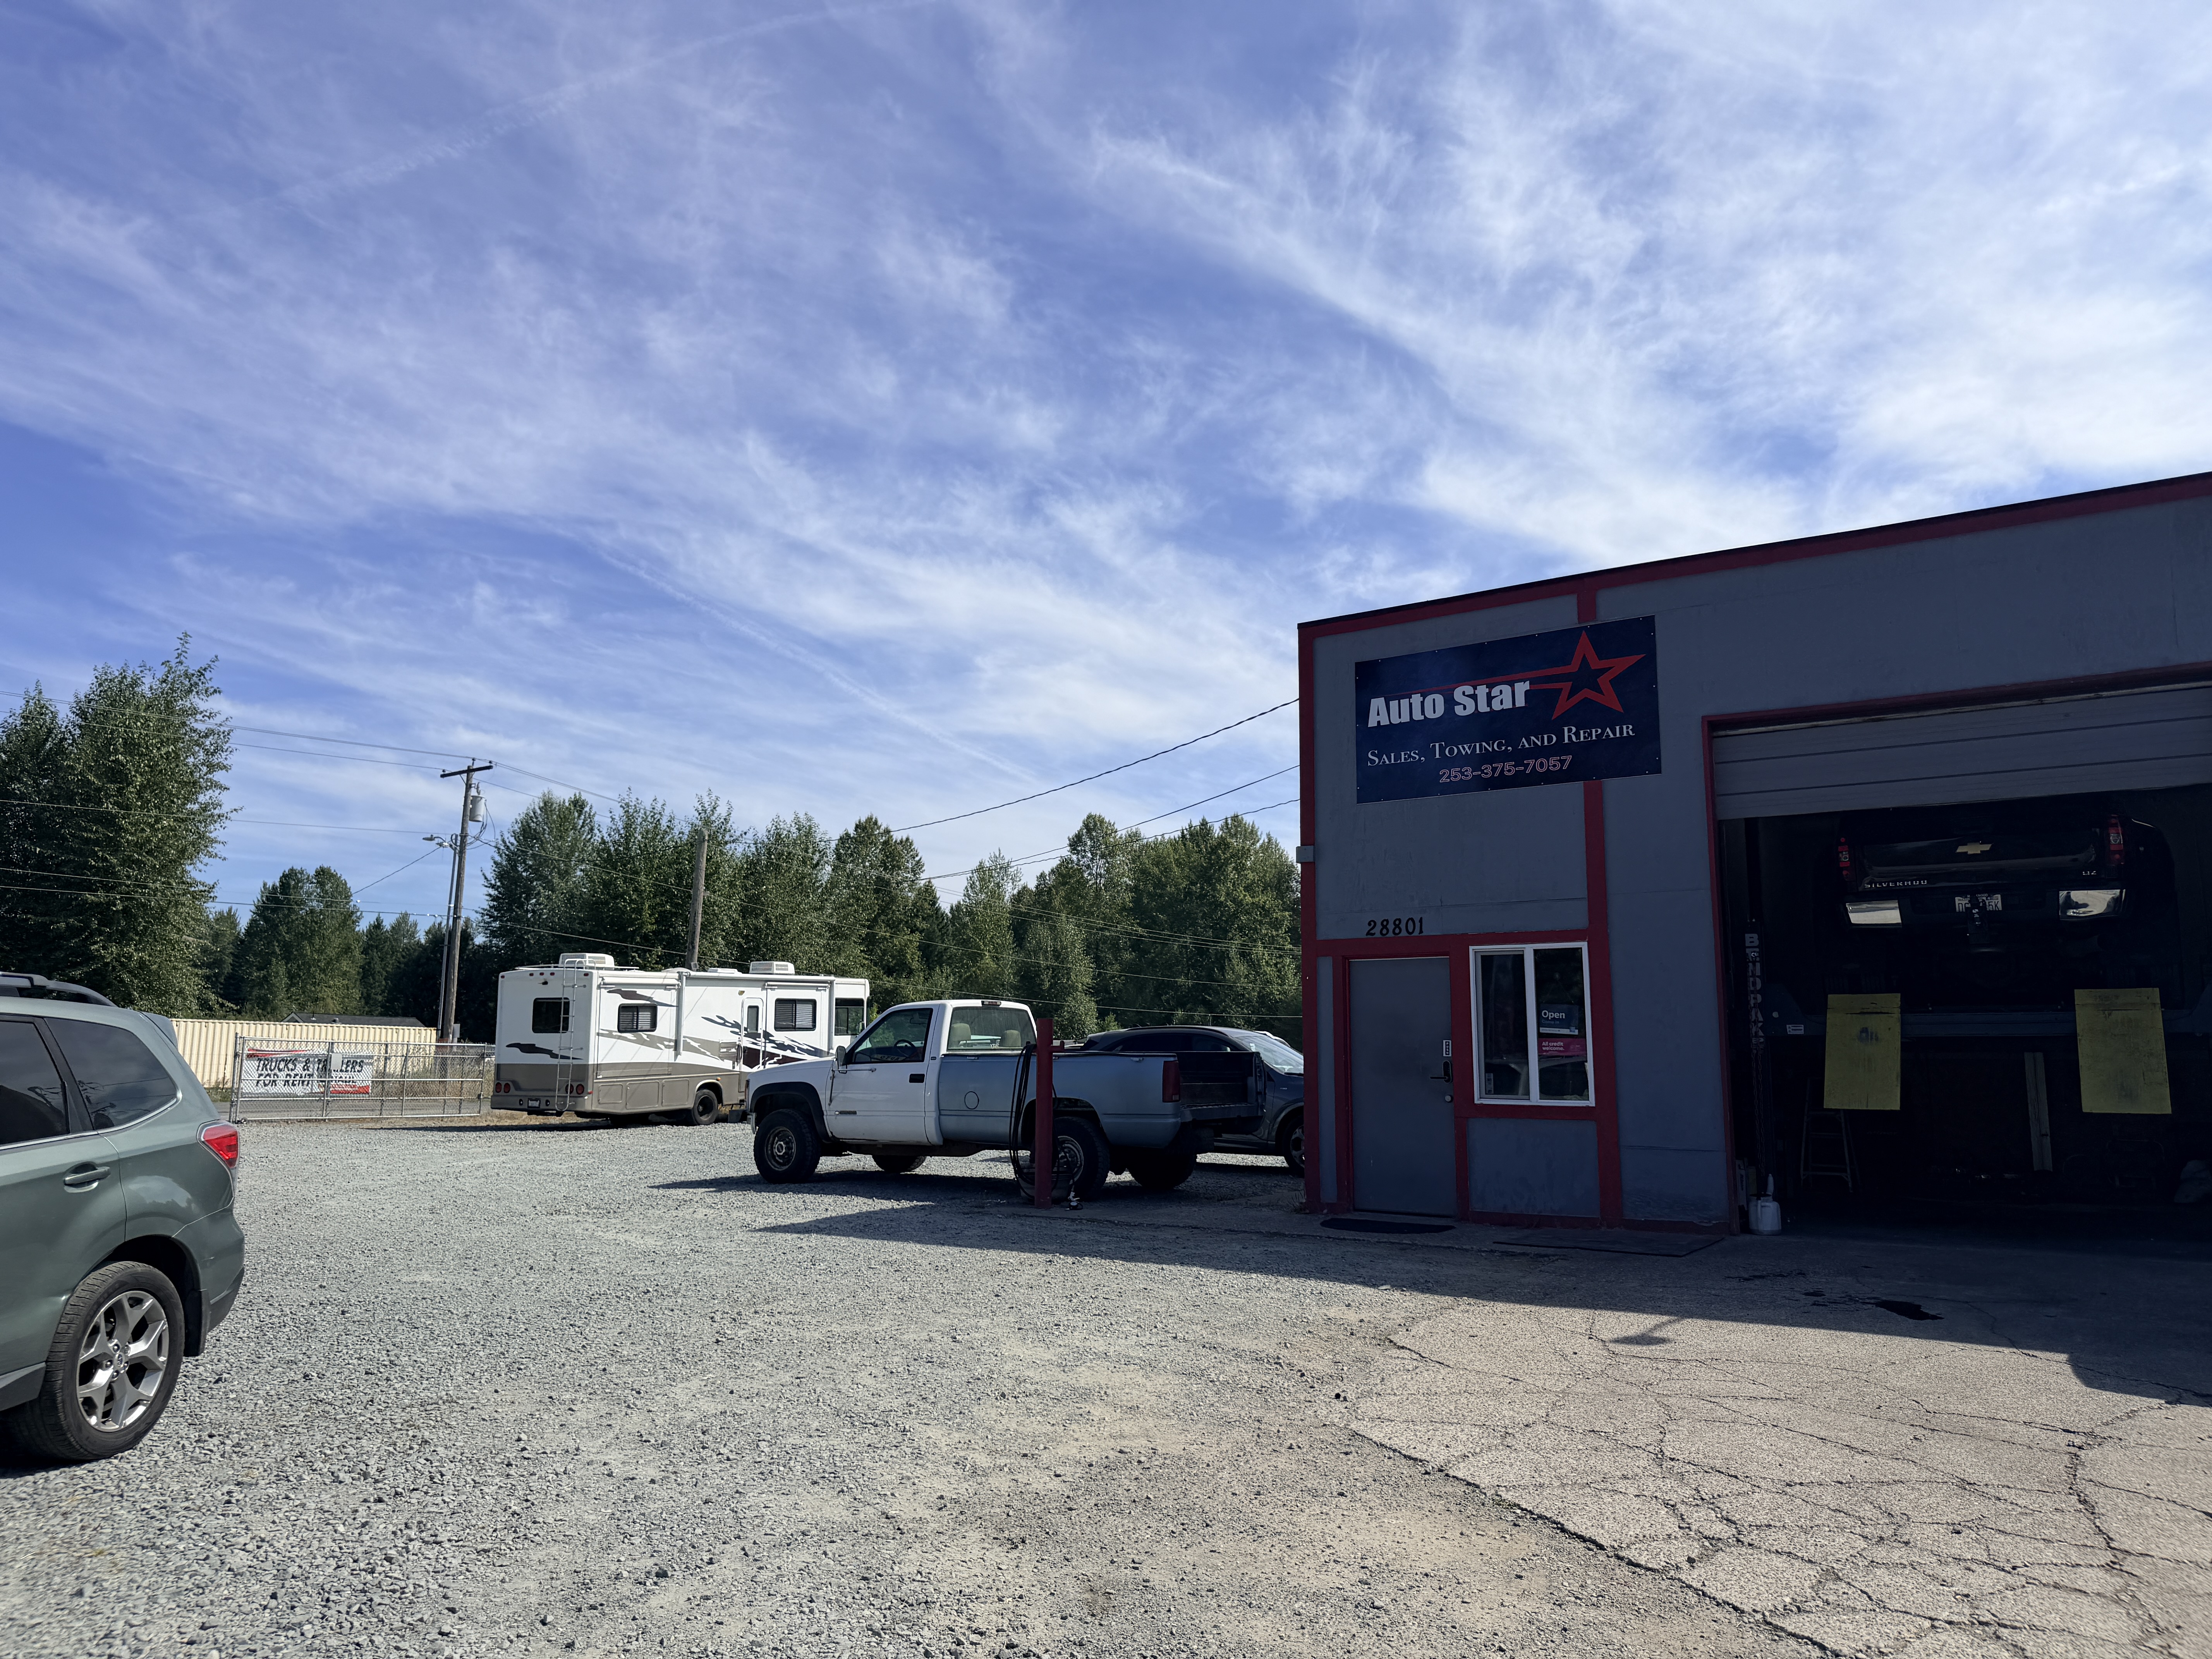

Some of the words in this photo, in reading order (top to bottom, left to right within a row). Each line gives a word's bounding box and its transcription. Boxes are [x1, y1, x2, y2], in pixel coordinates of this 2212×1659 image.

[1368, 693, 1444, 727] Auto
[1453, 680, 1529, 716] Star
[1439, 755, 1572, 783] 253-375-7057
[1365, 917, 1424, 937] 28801
[1541, 1010, 1566, 1020] Open
[256, 1058, 298, 1072] TRUCKS
[302, 1058, 311, 1072] &
[316, 1059, 364, 1072] TRLERS
[256, 1073, 279, 1087] FOR
[284, 1073, 314, 1087] RENT
